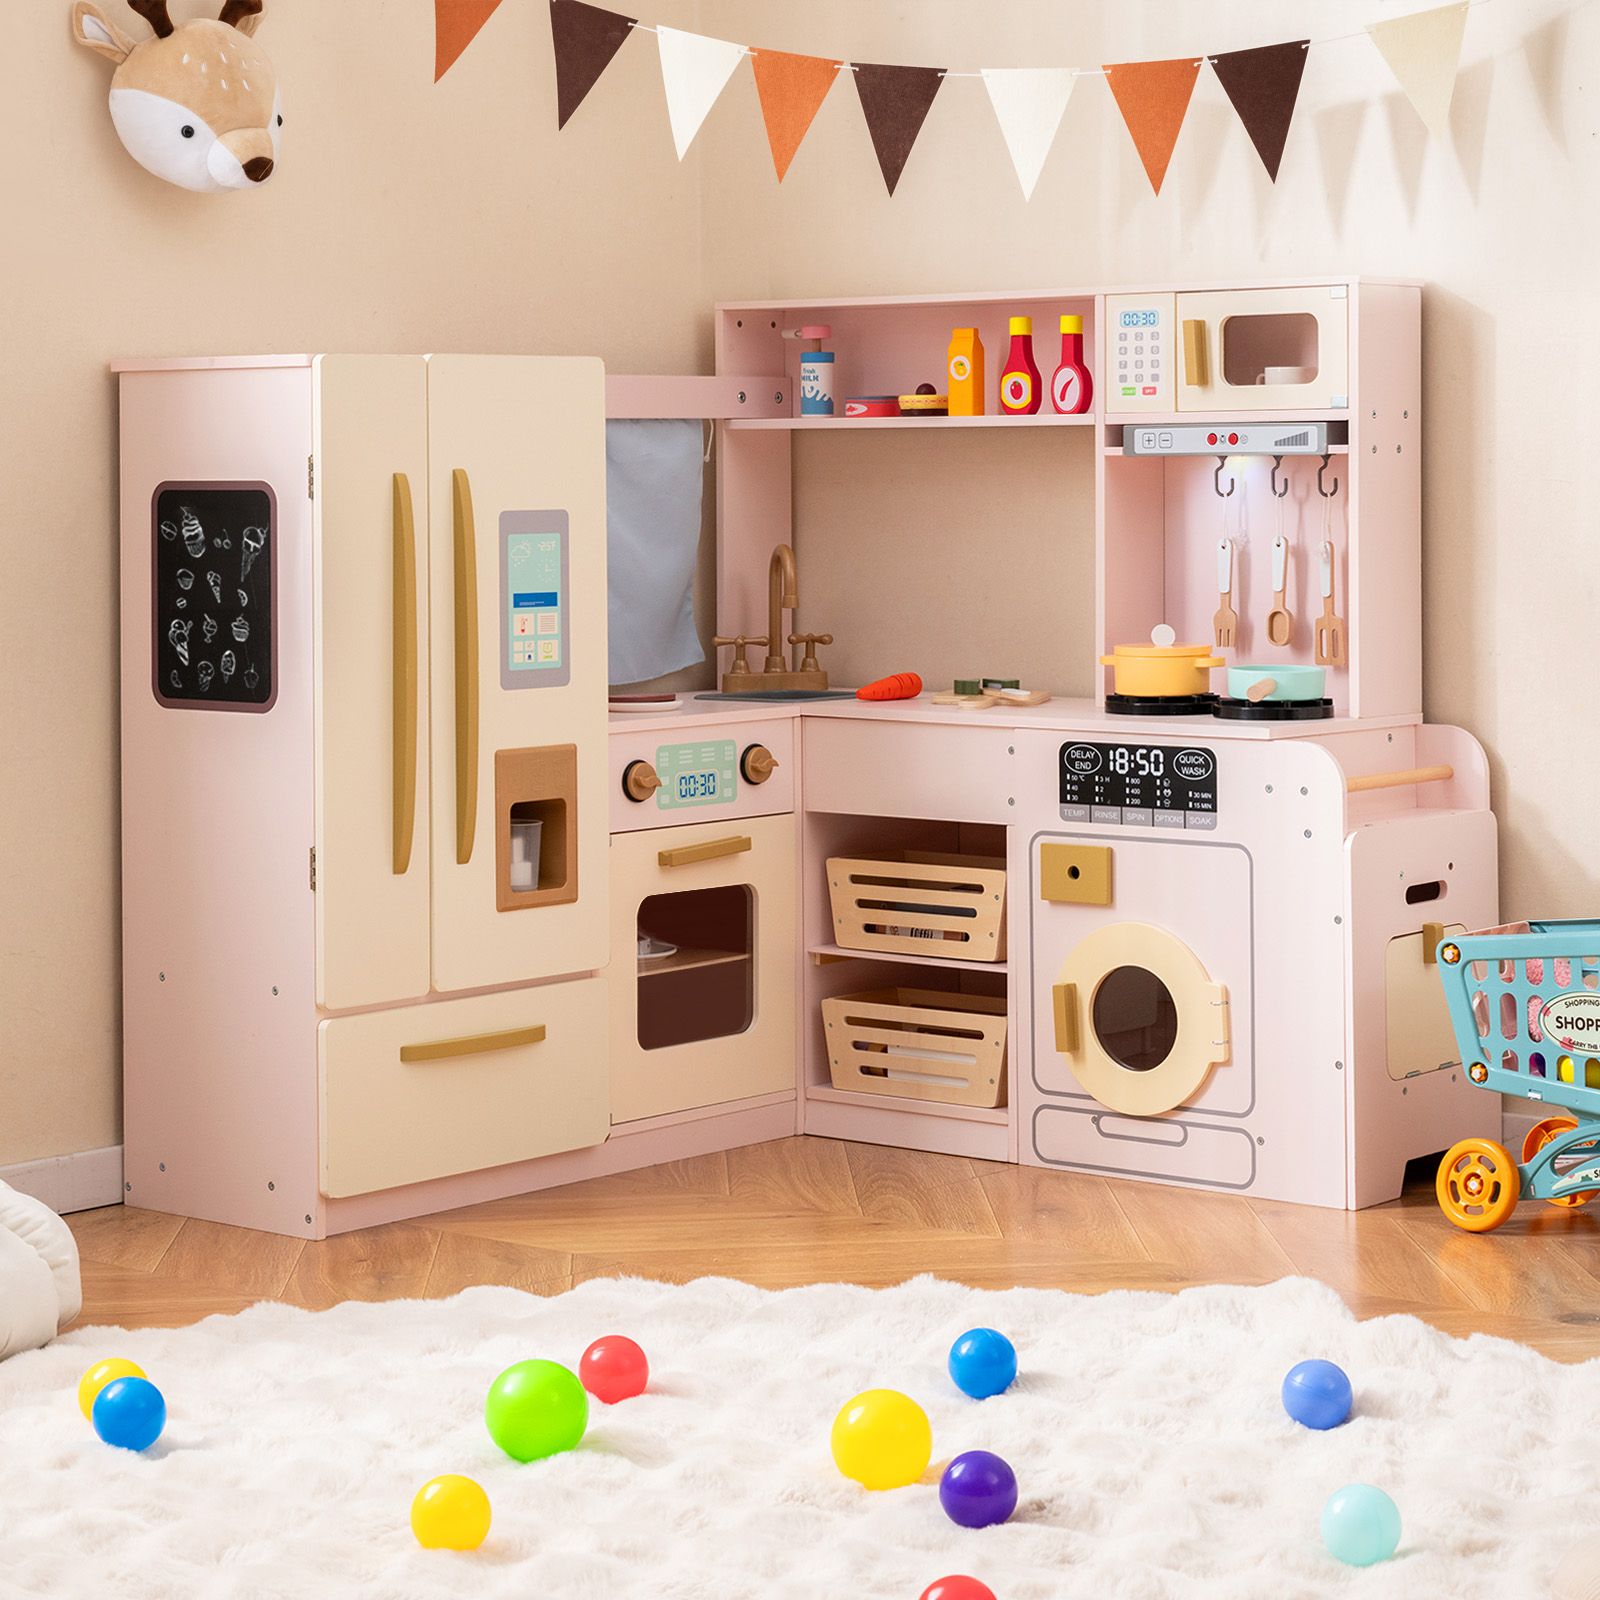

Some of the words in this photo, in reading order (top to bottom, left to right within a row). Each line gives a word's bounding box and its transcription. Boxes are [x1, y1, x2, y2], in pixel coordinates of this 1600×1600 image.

[1123, 312, 1156, 326] 00:30
[1070, 749, 1096, 760] DELAY
[1109, 748, 1164, 776] 18:50
[1178, 755, 1205, 765] QUICK
[1074, 761, 1092, 770] END
[1180, 766, 1206, 776] WASH
[680, 773, 716, 798] 00:30
[1063, 808, 1085, 817] TEMP
[1094, 810, 1118, 820] RINSE
[1126, 812, 1145, 821] SPIN
[1189, 816, 1212, 825] SOAK
[1568, 1038, 1586, 1048] CARRY
[1593, 1169, 1600, 1179] S
